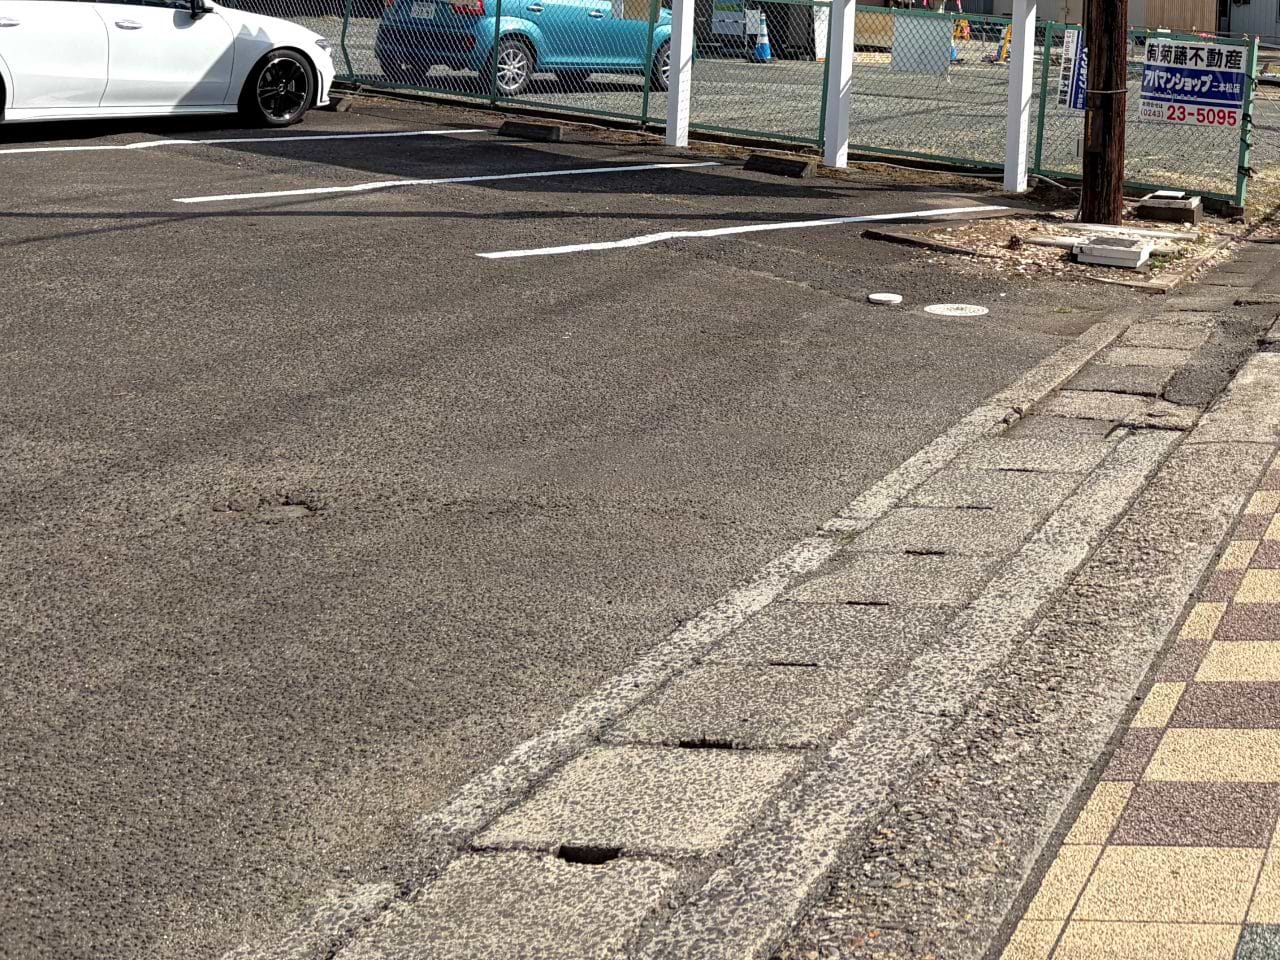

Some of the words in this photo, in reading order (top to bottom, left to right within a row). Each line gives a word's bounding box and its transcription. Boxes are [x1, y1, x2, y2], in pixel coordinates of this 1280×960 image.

[1144, 70, 1213, 92] アパマンショップ
[1212, 82, 1241, 93] 二本松店
[1140, 108, 1164, 119] (0243)
[1167, 104, 1237, 127] 23-5095
